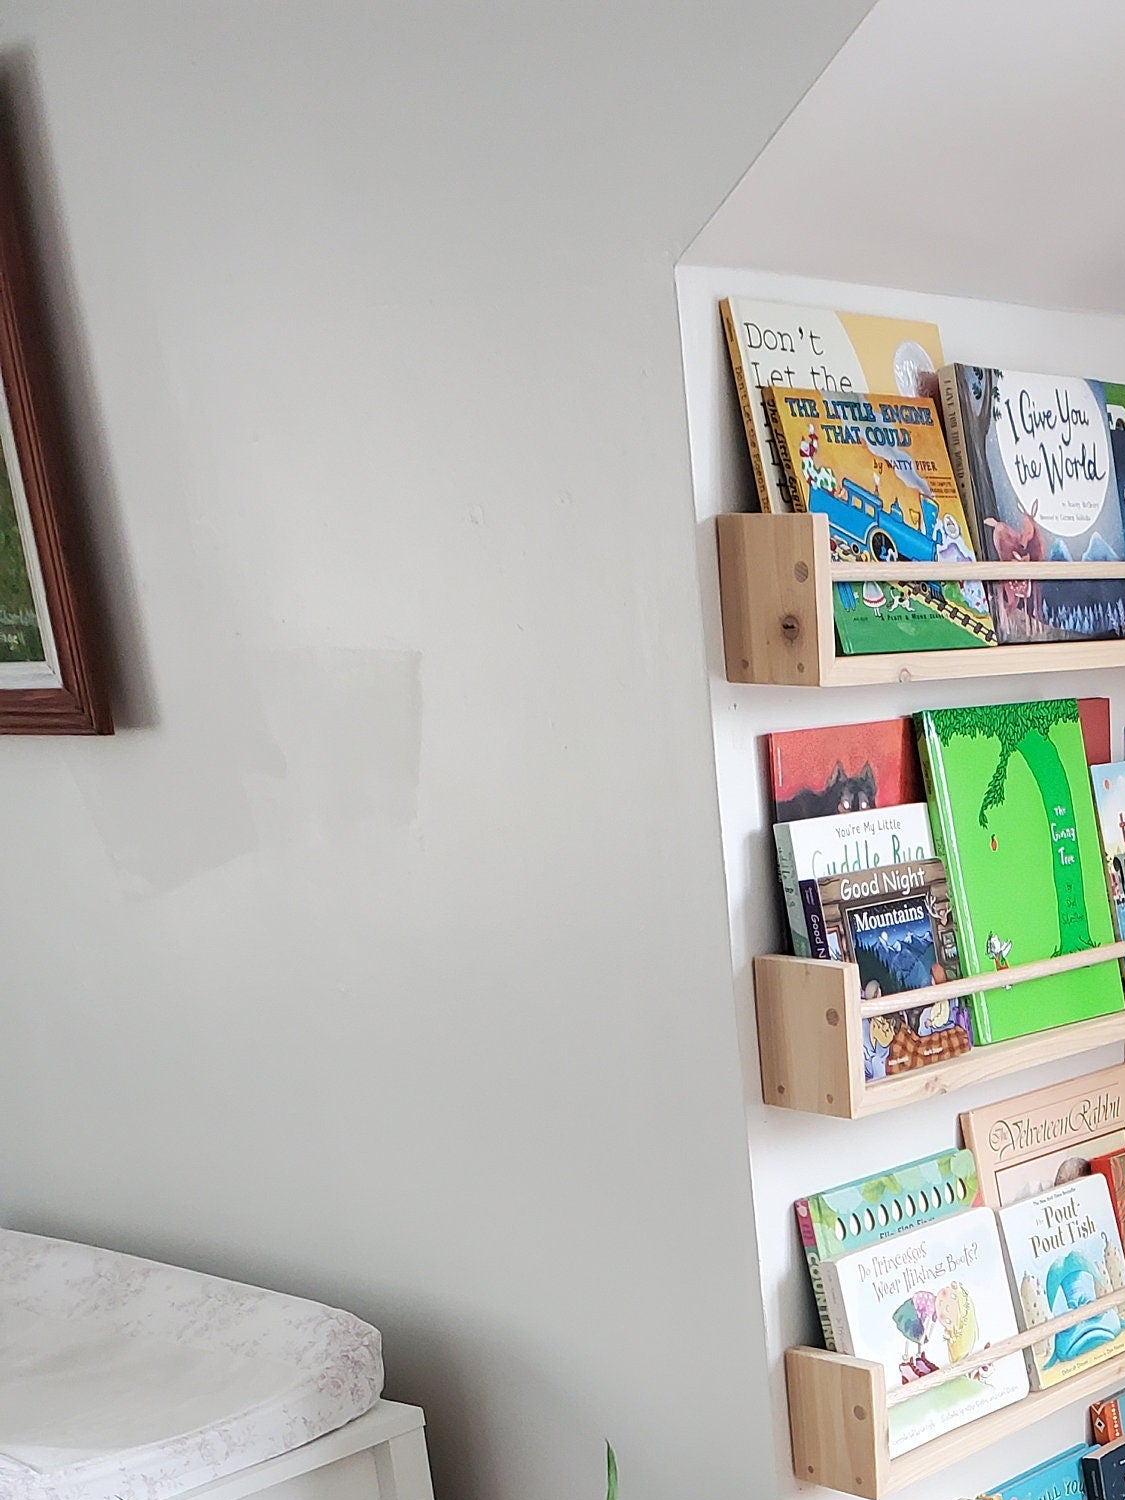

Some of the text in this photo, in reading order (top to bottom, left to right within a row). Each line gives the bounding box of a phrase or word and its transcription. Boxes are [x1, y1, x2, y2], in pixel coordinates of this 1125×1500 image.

[744, 322, 824, 356] Don't
[751, 362, 853, 393] Let the
[784, 397, 935, 426] THE LITTLE ENGINE
[1005, 388, 1089, 446] I Give You
[821, 424, 912, 447] THAT COULD
[873, 459, 938, 474] by WATTY PIPER
[1015, 442, 1106, 495] the World
[835, 819, 901, 839] You're My Little
[1058, 846, 1075, 866] Tree
[840, 866, 925, 901] Good Night
[811, 914, 825, 944] Good
[853, 904, 924, 933] Mountains
[1028, 1215, 1096, 1259] Pout Fish
[858, 1241, 929, 1282] Do Princesses
[872, 1280, 901, 1303] Wear
[902, 1262, 946, 1293] Hiking
[947, 1241, 979, 1273] Boots?
[807, 1253, 838, 1352] COUNTING
[1063, 1480, 1085, 1497] YOU
